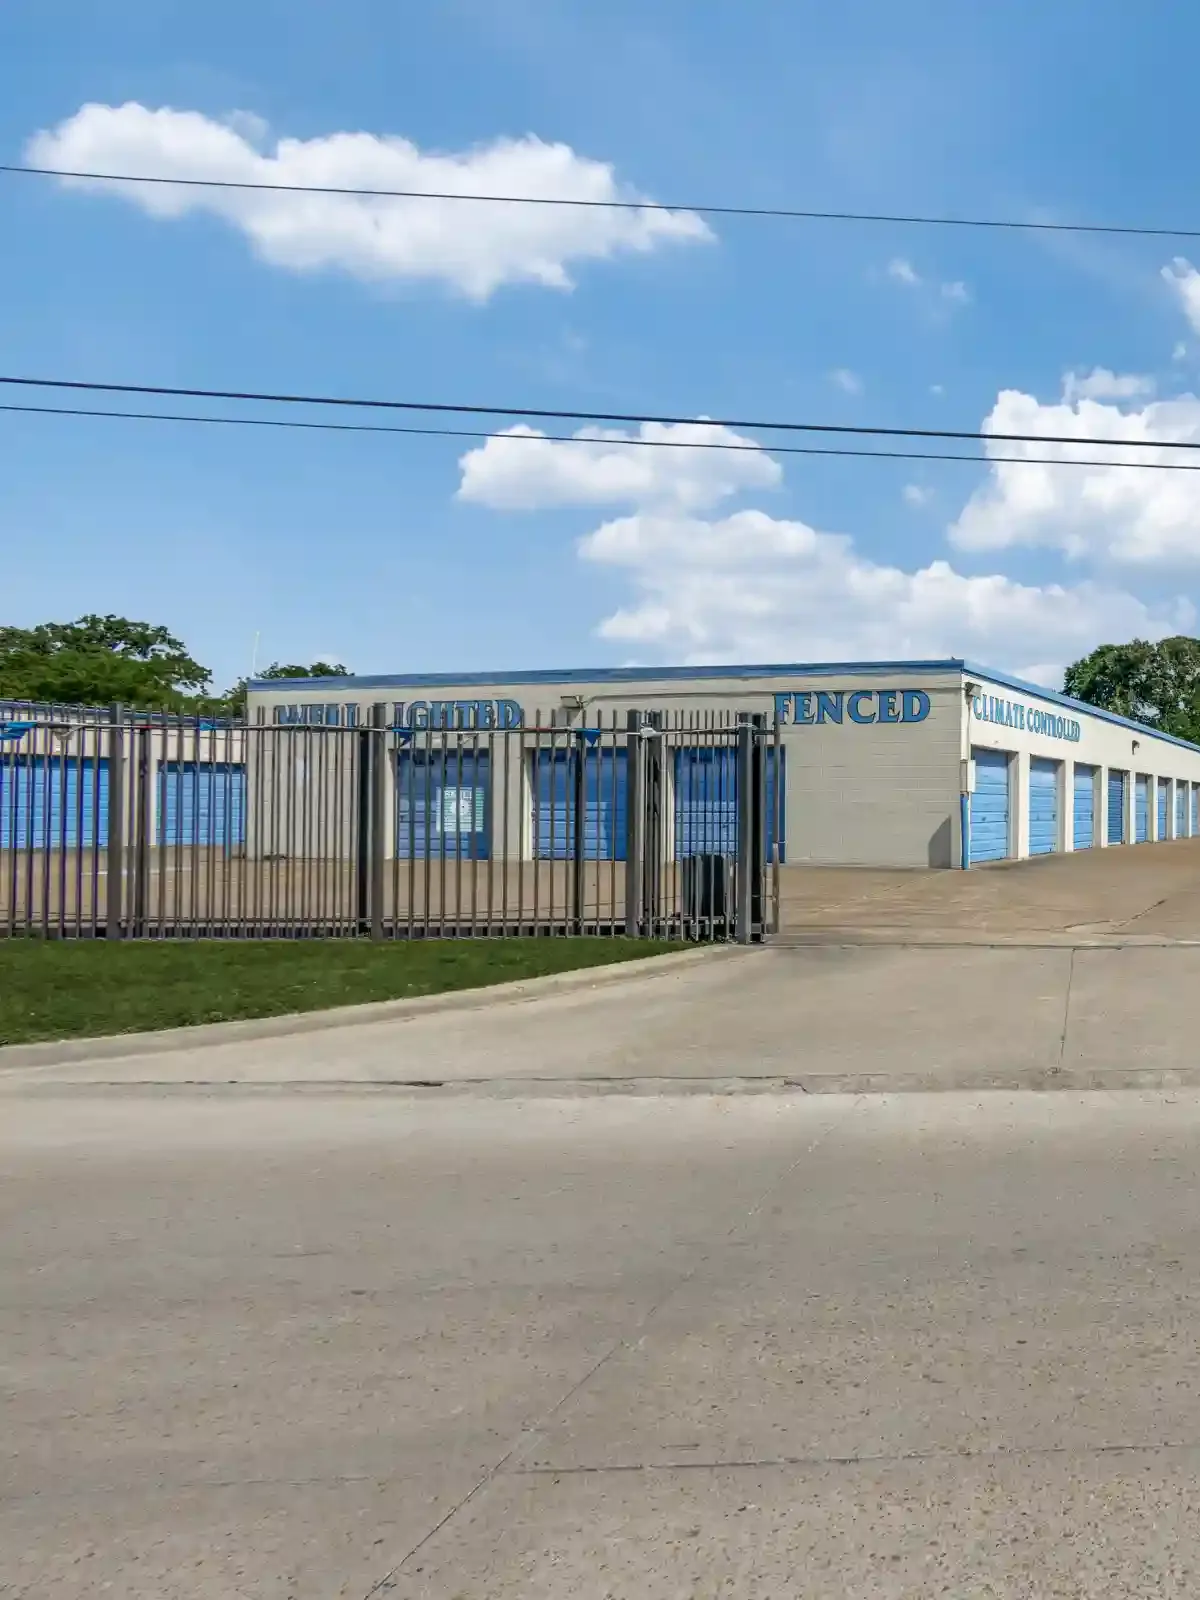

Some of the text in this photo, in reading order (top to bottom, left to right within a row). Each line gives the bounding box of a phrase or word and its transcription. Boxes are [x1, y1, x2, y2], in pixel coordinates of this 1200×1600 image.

[378, 699, 522, 730] IGHTED
[772, 690, 931, 725] FENCED
[972, 694, 1081, 742] CLIMATE CONTROLLED
